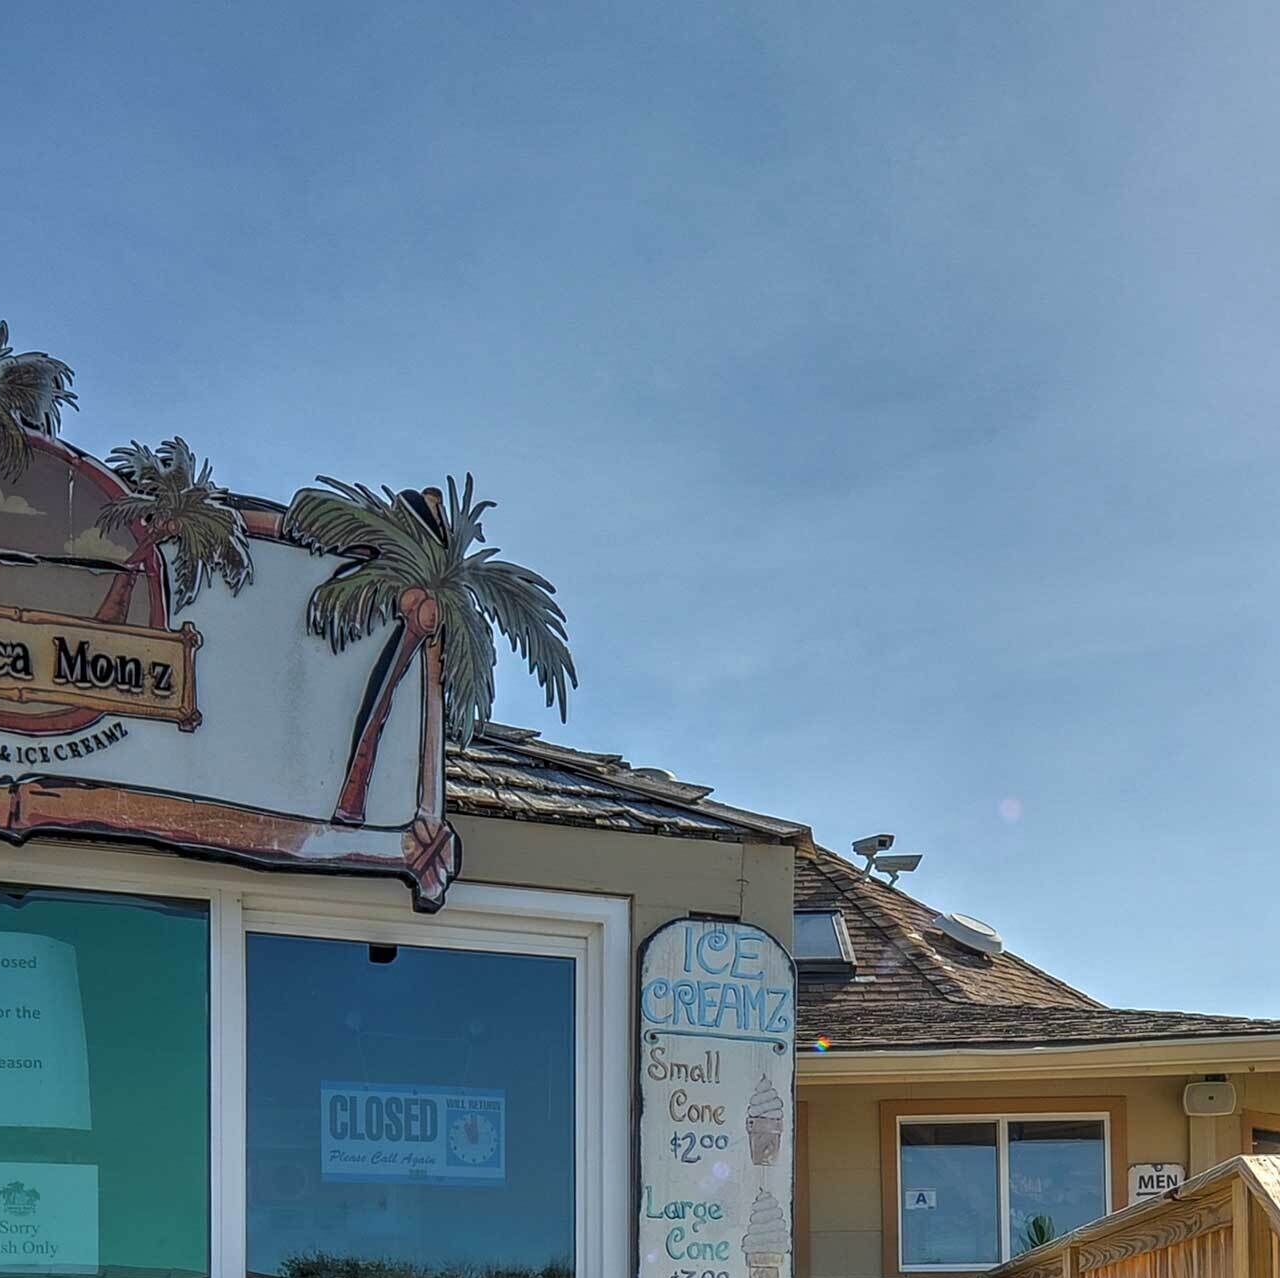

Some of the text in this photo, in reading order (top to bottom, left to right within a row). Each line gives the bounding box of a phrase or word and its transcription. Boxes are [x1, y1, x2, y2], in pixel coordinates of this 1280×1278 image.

[17, 745, 51, 765] ICE
[53, 720, 129, 763] CREAMZ
[681, 925, 767, 982] ICE
[16, 1005, 41, 1020] the
[641, 976, 791, 1035] CREAMZ
[647, 1046, 722, 1085] Small
[329, 1094, 439, 1143] CLOSED
[669, 1089, 726, 1125] Cone
[329, 1150, 436, 1167] Please Call Again
[915, 1192, 928, 1205] A
[1138, 1174, 1179, 1191] MEN
[643, 1185, 724, 1234] Large
[0, 1220, 40, 1238] Sorry
[665, 1225, 730, 1262] Cone
[22, 1240, 59, 1258] Only
